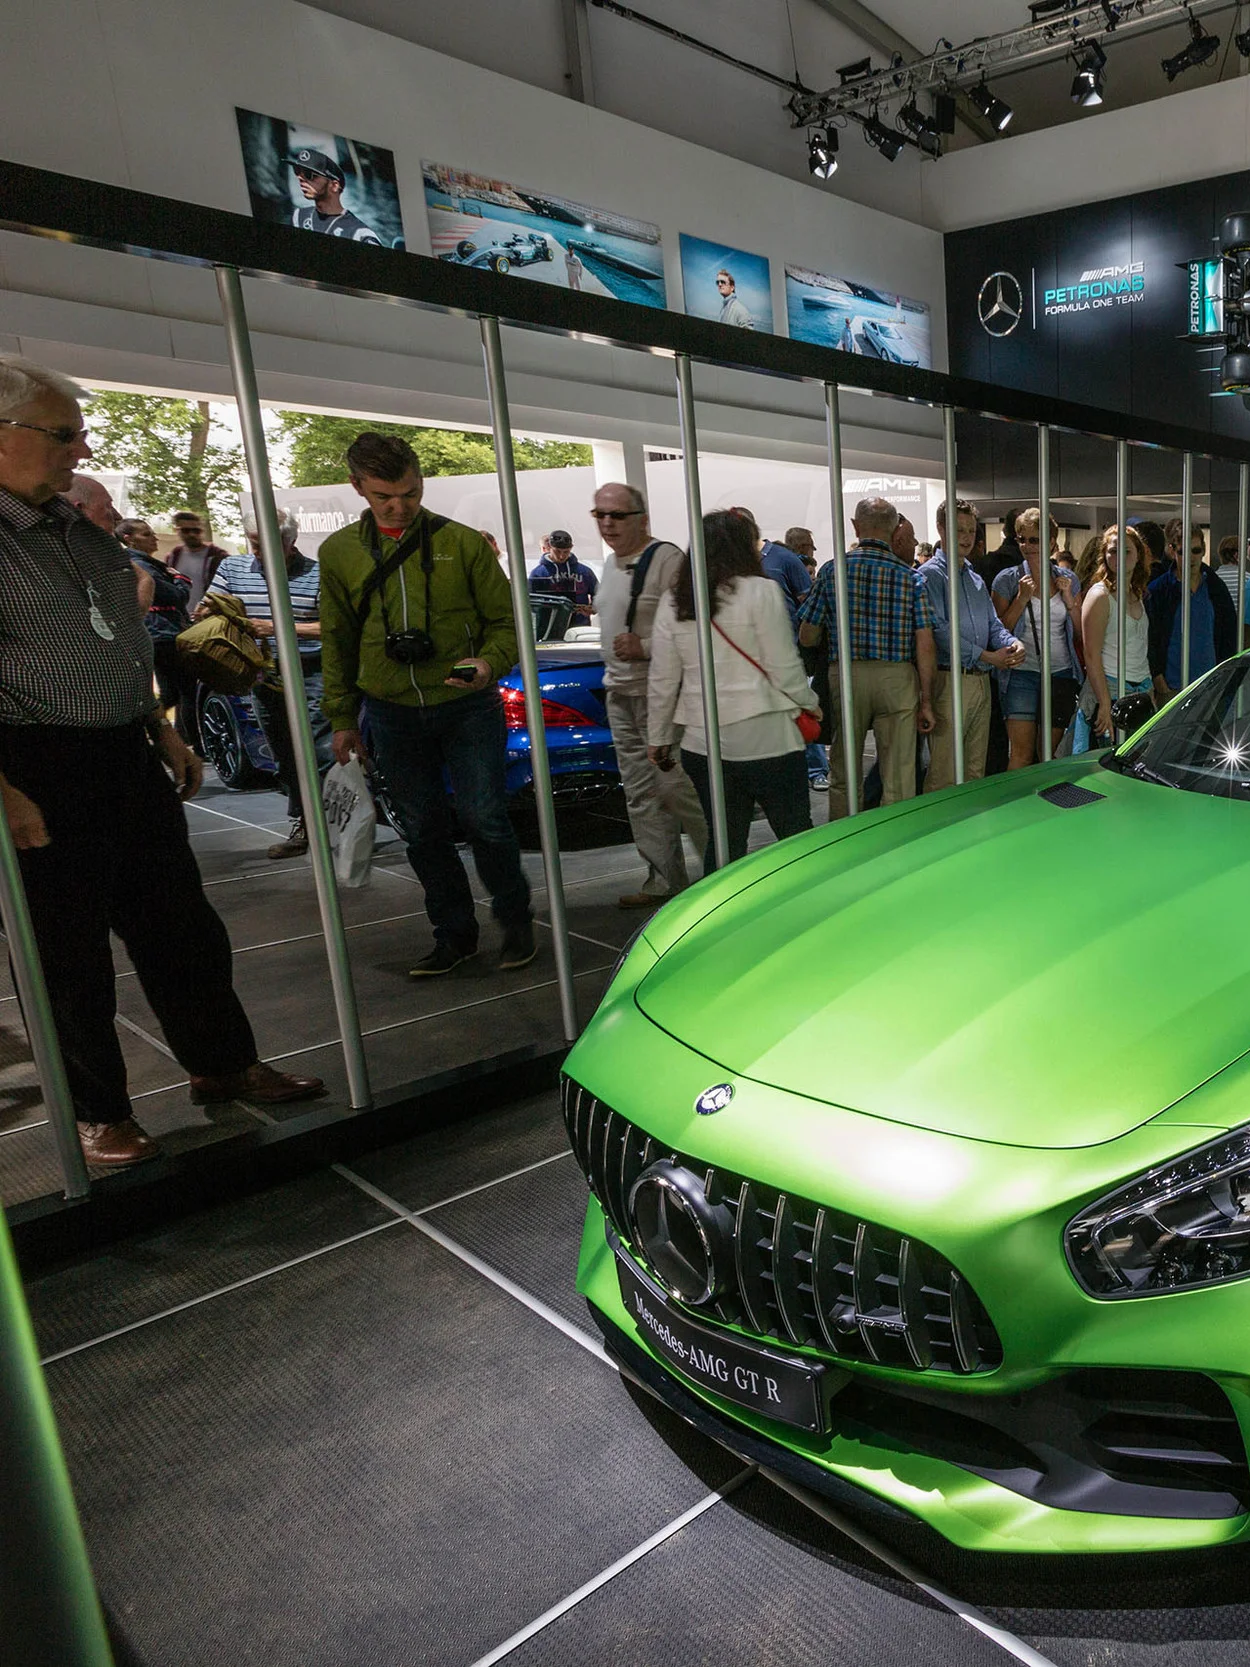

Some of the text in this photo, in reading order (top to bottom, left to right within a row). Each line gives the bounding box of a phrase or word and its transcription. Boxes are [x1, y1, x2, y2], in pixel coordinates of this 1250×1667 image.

[1044, 275, 1144, 305] PETRONAS
[1045, 293, 1144, 316] FORMULA ONE TEAM
[1190, 262, 1199, 333] PETRONAS
[634, 1291, 781, 1403] Mercedes-AMG GT R
